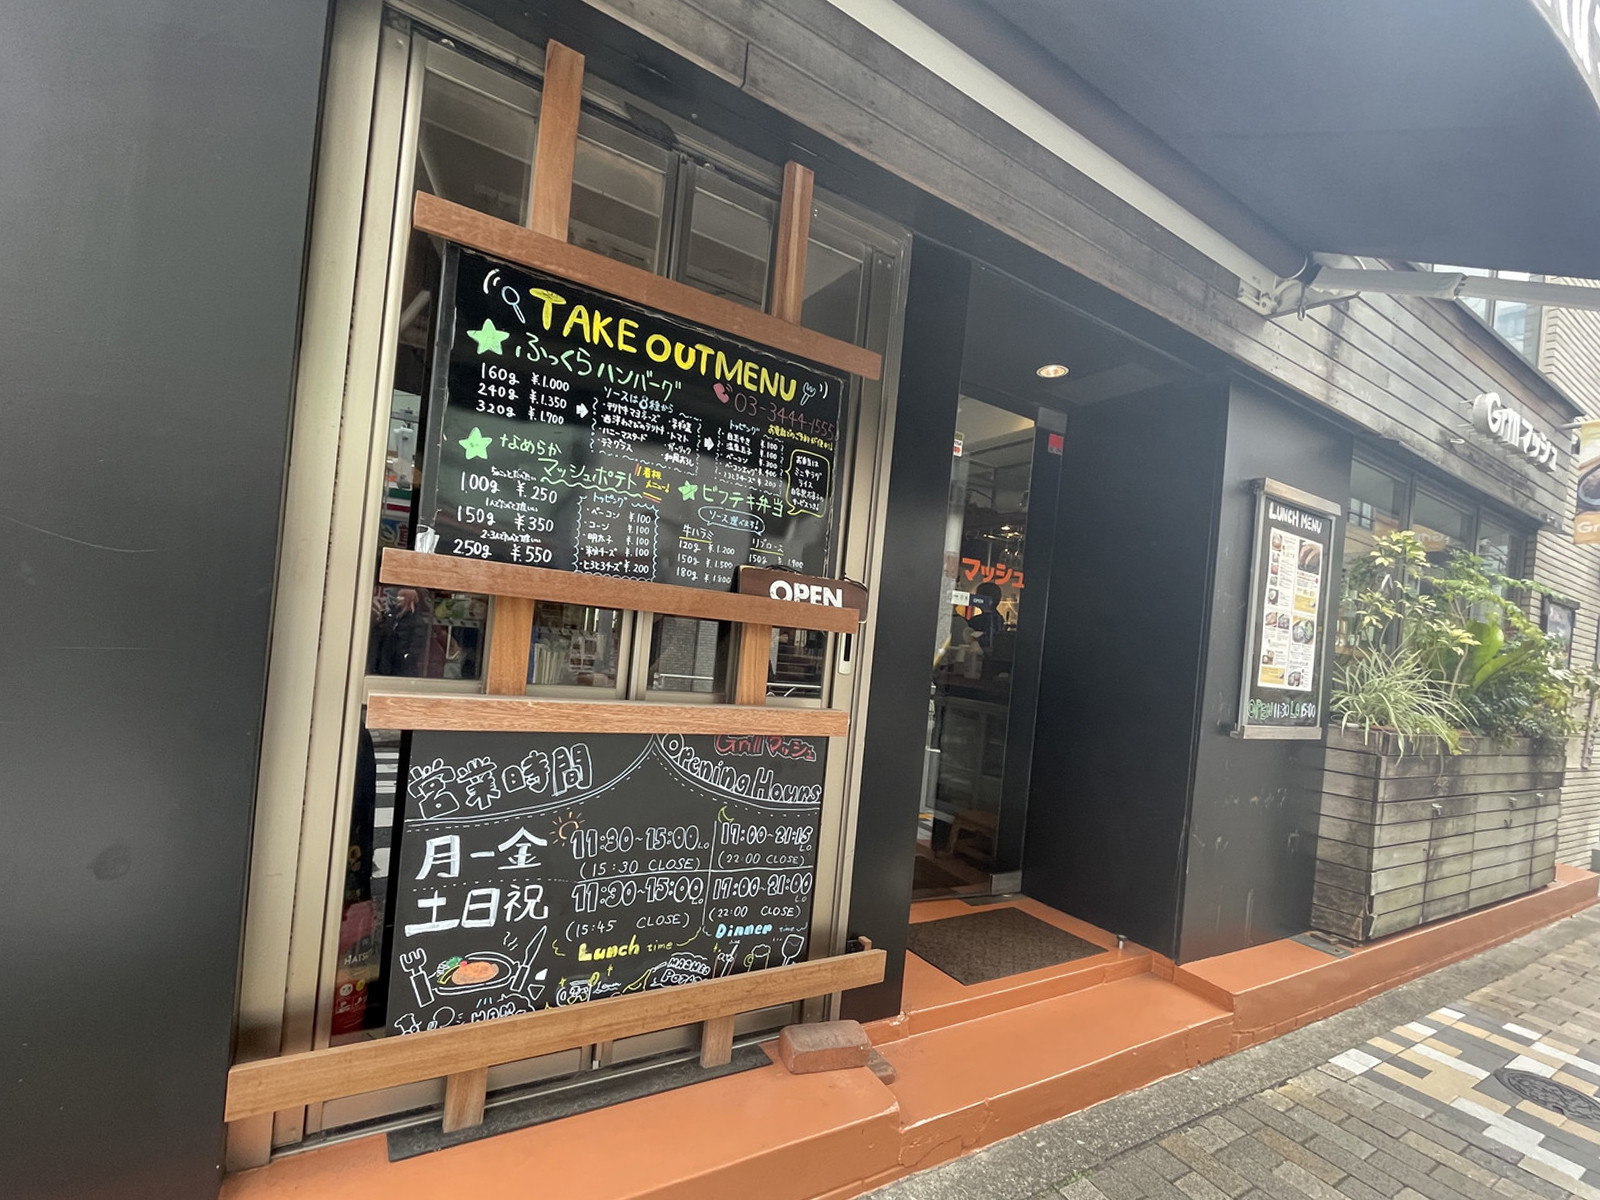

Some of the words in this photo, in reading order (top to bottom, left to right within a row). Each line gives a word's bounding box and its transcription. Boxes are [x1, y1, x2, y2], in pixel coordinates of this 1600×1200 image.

[529, 287, 640, 354] TAKE
[481, 362, 520, 386] 160g
[477, 382, 519, 401] 240g
[475, 399, 516, 418] 320g
[734, 392, 835, 441] 03-3444-1555
[499, 433, 562, 457] なめらか
[537, 457, 637, 490] マッシュポテト
[702, 483, 784, 518] ビフテキ弁当
[457, 505, 496, 526] 150g
[1268, 501, 1300, 528] LUNCH
[1300, 513, 1323, 534] MENU
[681, 523, 714, 541] 牛ハラミ
[677, 553, 700, 566] 150g
[678, 539, 701, 554] 120g
[676, 566, 699, 581] 180g
[962, 557, 1025, 589] マッシュ
[769, 579, 843, 608] OPEN
[661, 733, 751, 794] Opening
[752, 767, 822, 802] Hours
[406, 742, 593, 820] 営業時間
[404, 884, 549, 937] 土日祝
[714, 923, 774, 939] Dinner
[578, 934, 640, 963] Lunch
[646, 941, 673, 952] time
[666, 957, 711, 976] MASHED
